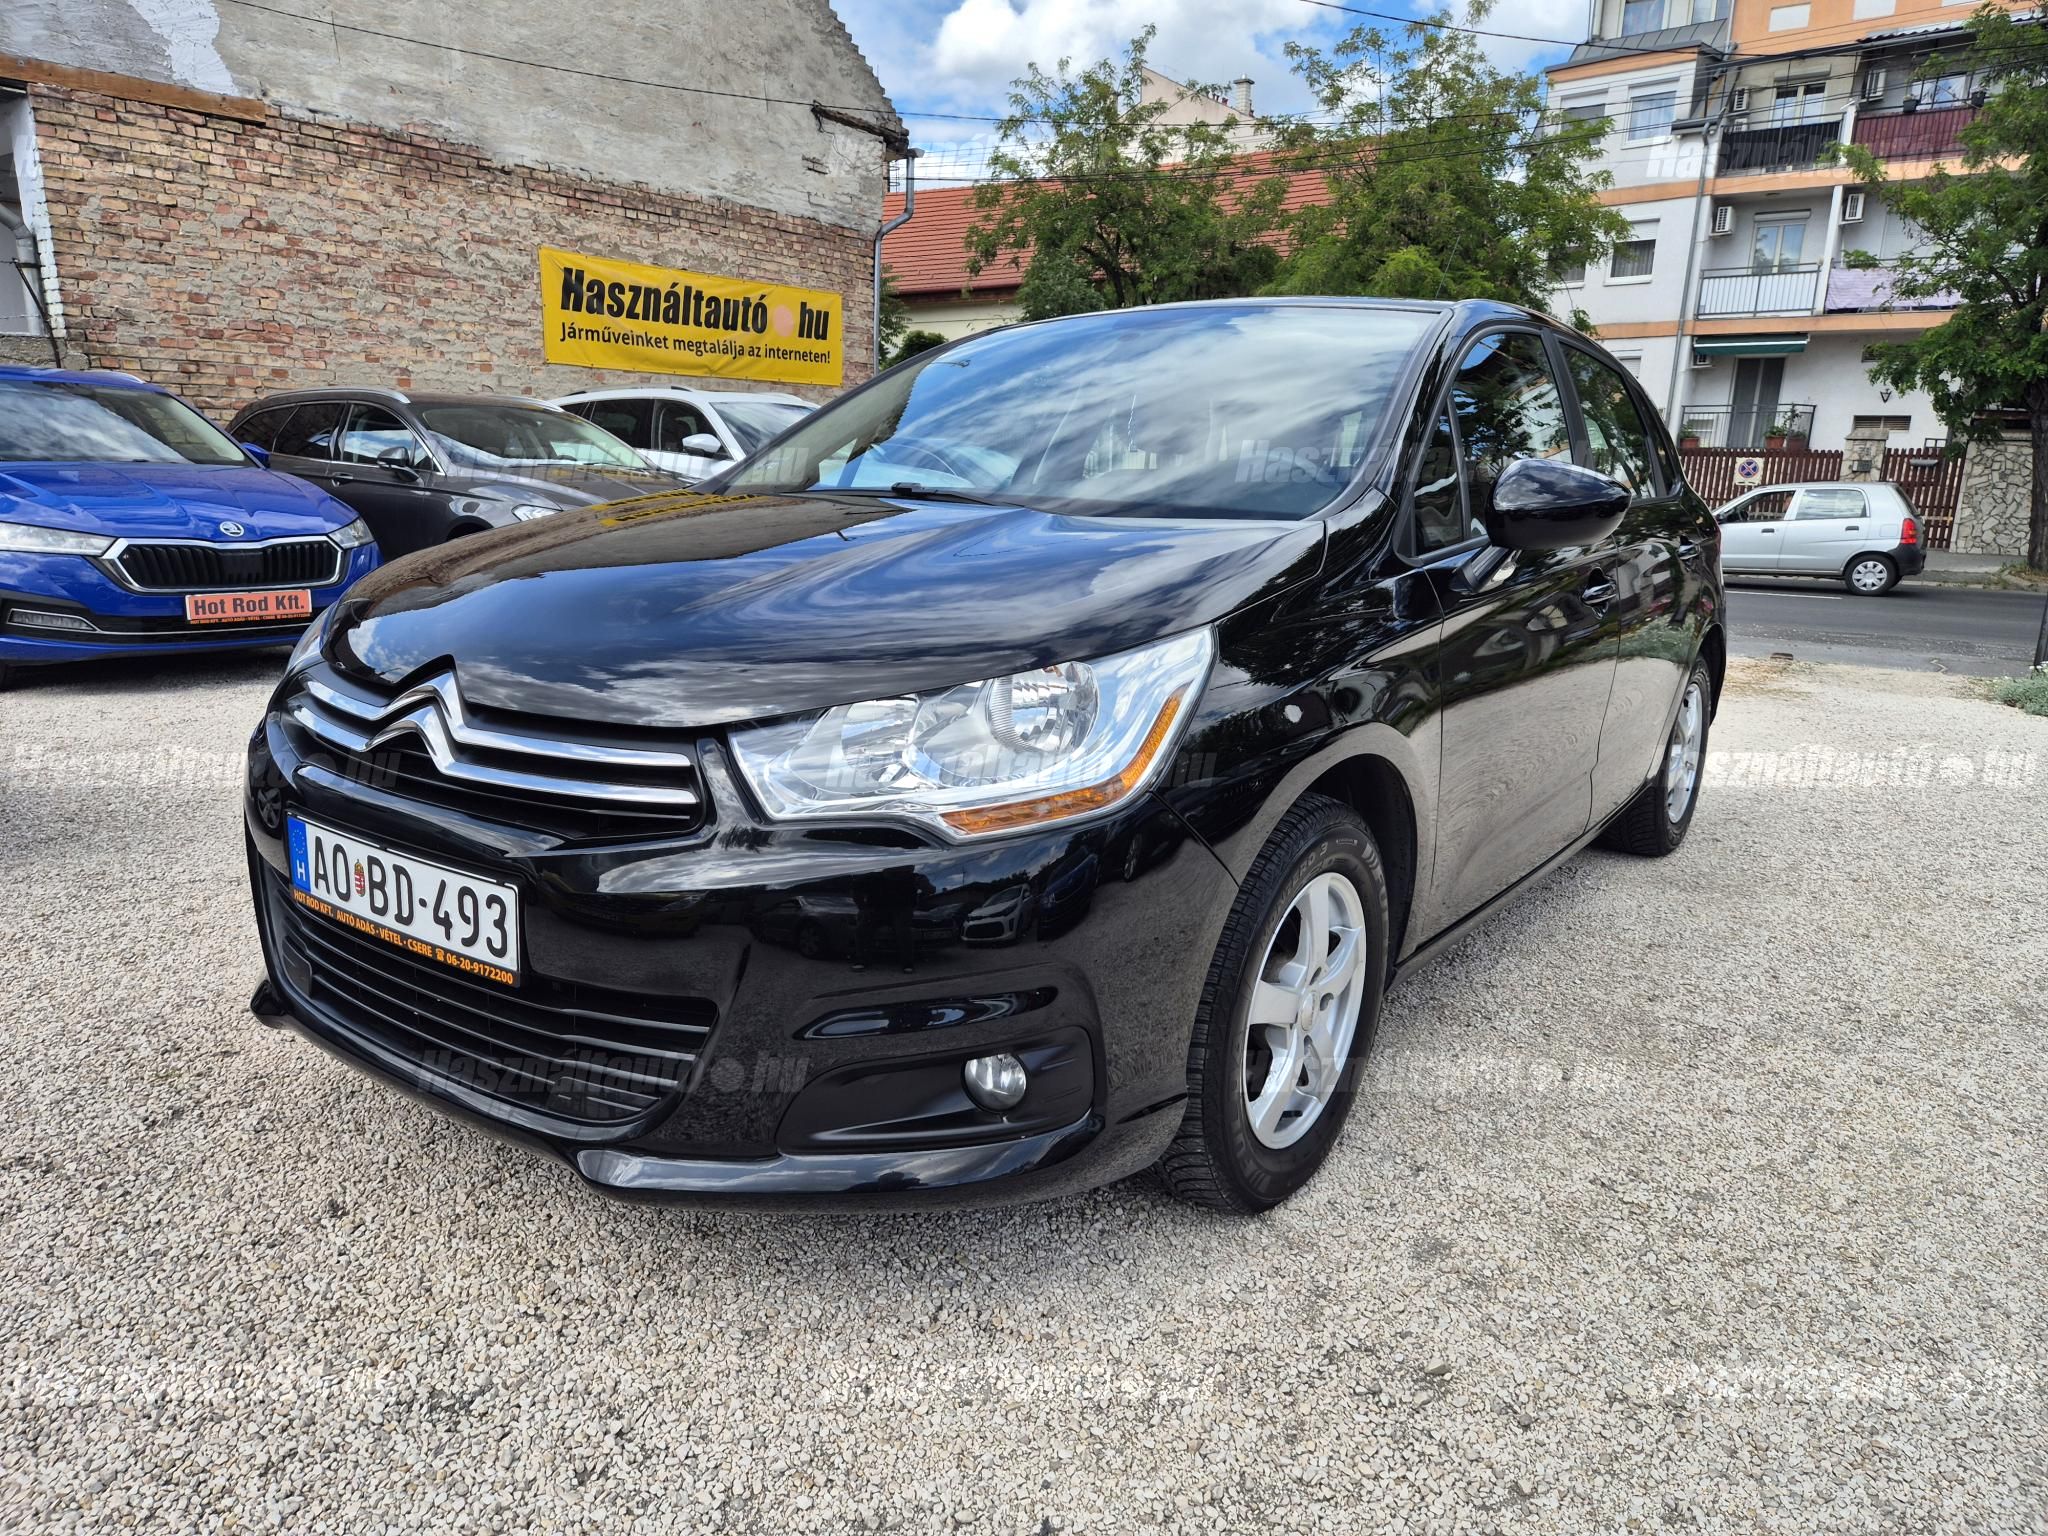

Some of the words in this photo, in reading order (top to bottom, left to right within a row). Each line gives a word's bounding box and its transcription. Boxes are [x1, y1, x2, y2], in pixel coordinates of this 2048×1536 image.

[560, 322, 669, 349] Járműveinket
[673, 338, 744, 360] megtalálja
[748, 345, 760, 357] az
[765, 344, 830, 364] interneten!
[194, 599, 226, 616] Hot
[232, 596, 269, 613] Rod
[275, 594, 305, 611] Kft.
[296, 860, 307, 882] H
[314, 835, 351, 902] AO
[367, 855, 508, 959] BD-493
[294, 890, 306, 904] HOT
[306, 896, 320, 910] ROD
[320, 903, 334, 917] KFT.
[336, 909, 355, 927] AUTÓ
[356, 917, 376, 935] ADÁS
[379, 927, 403, 946] VÉTEL
[407, 938, 433, 957] CSERE
[446, 952, 514, 984] 06-20-9172200
